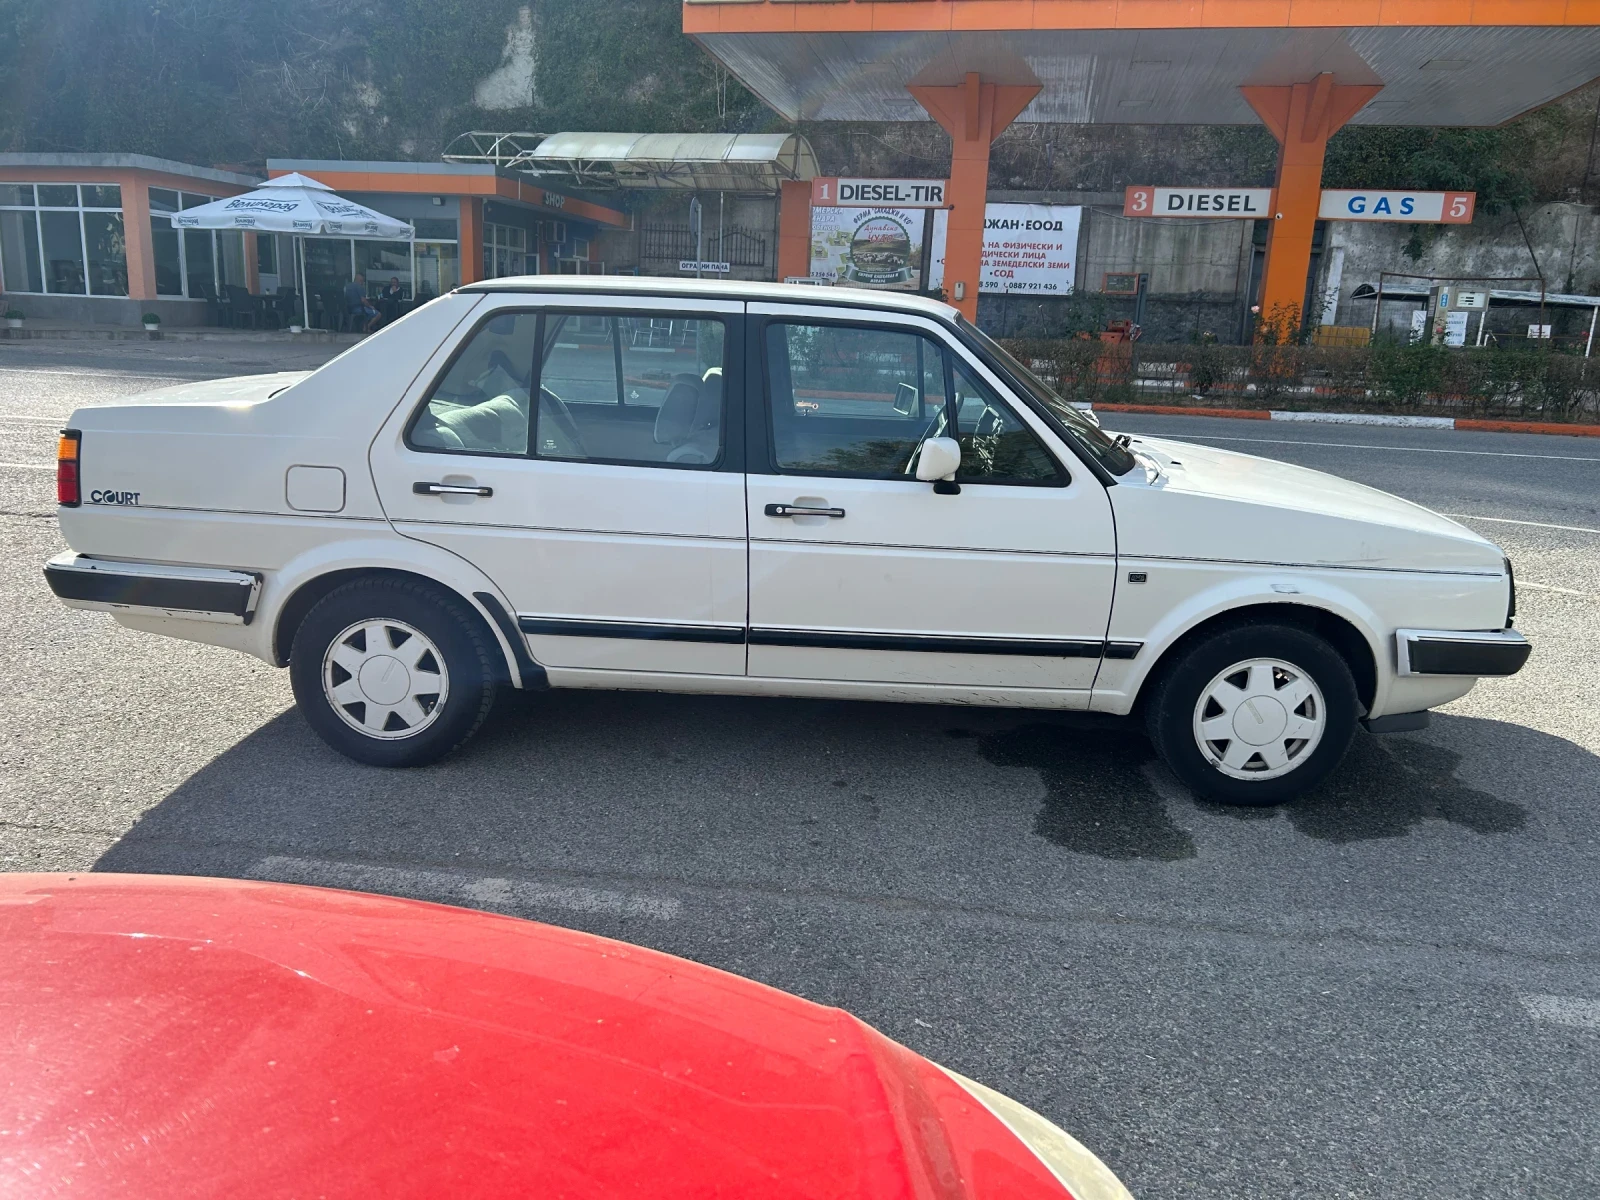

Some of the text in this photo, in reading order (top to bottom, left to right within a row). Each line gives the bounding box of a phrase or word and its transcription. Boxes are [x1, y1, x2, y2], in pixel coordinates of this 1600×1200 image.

[820, 183, 943, 202] 1 DIESEL-TIR
[225, 199, 299, 212] Велинград
[545, 191, 565, 209] SHOP
[1132, 191, 1257, 212] 3 DIESEL
[1347, 196, 1468, 218] GAS 5
[1002, 242, 1053, 250] ФИЗИЧЕСКИ
[1022, 252, 1046, 260] ЛИЦА
[681, 262, 710, 270] ОГРАНИ
[992, 260, 1045, 269] ЗЕМЕДЕЛСКИ
[994, 269, 1014, 278] СОД
[91, 489, 141, 505] COURT
